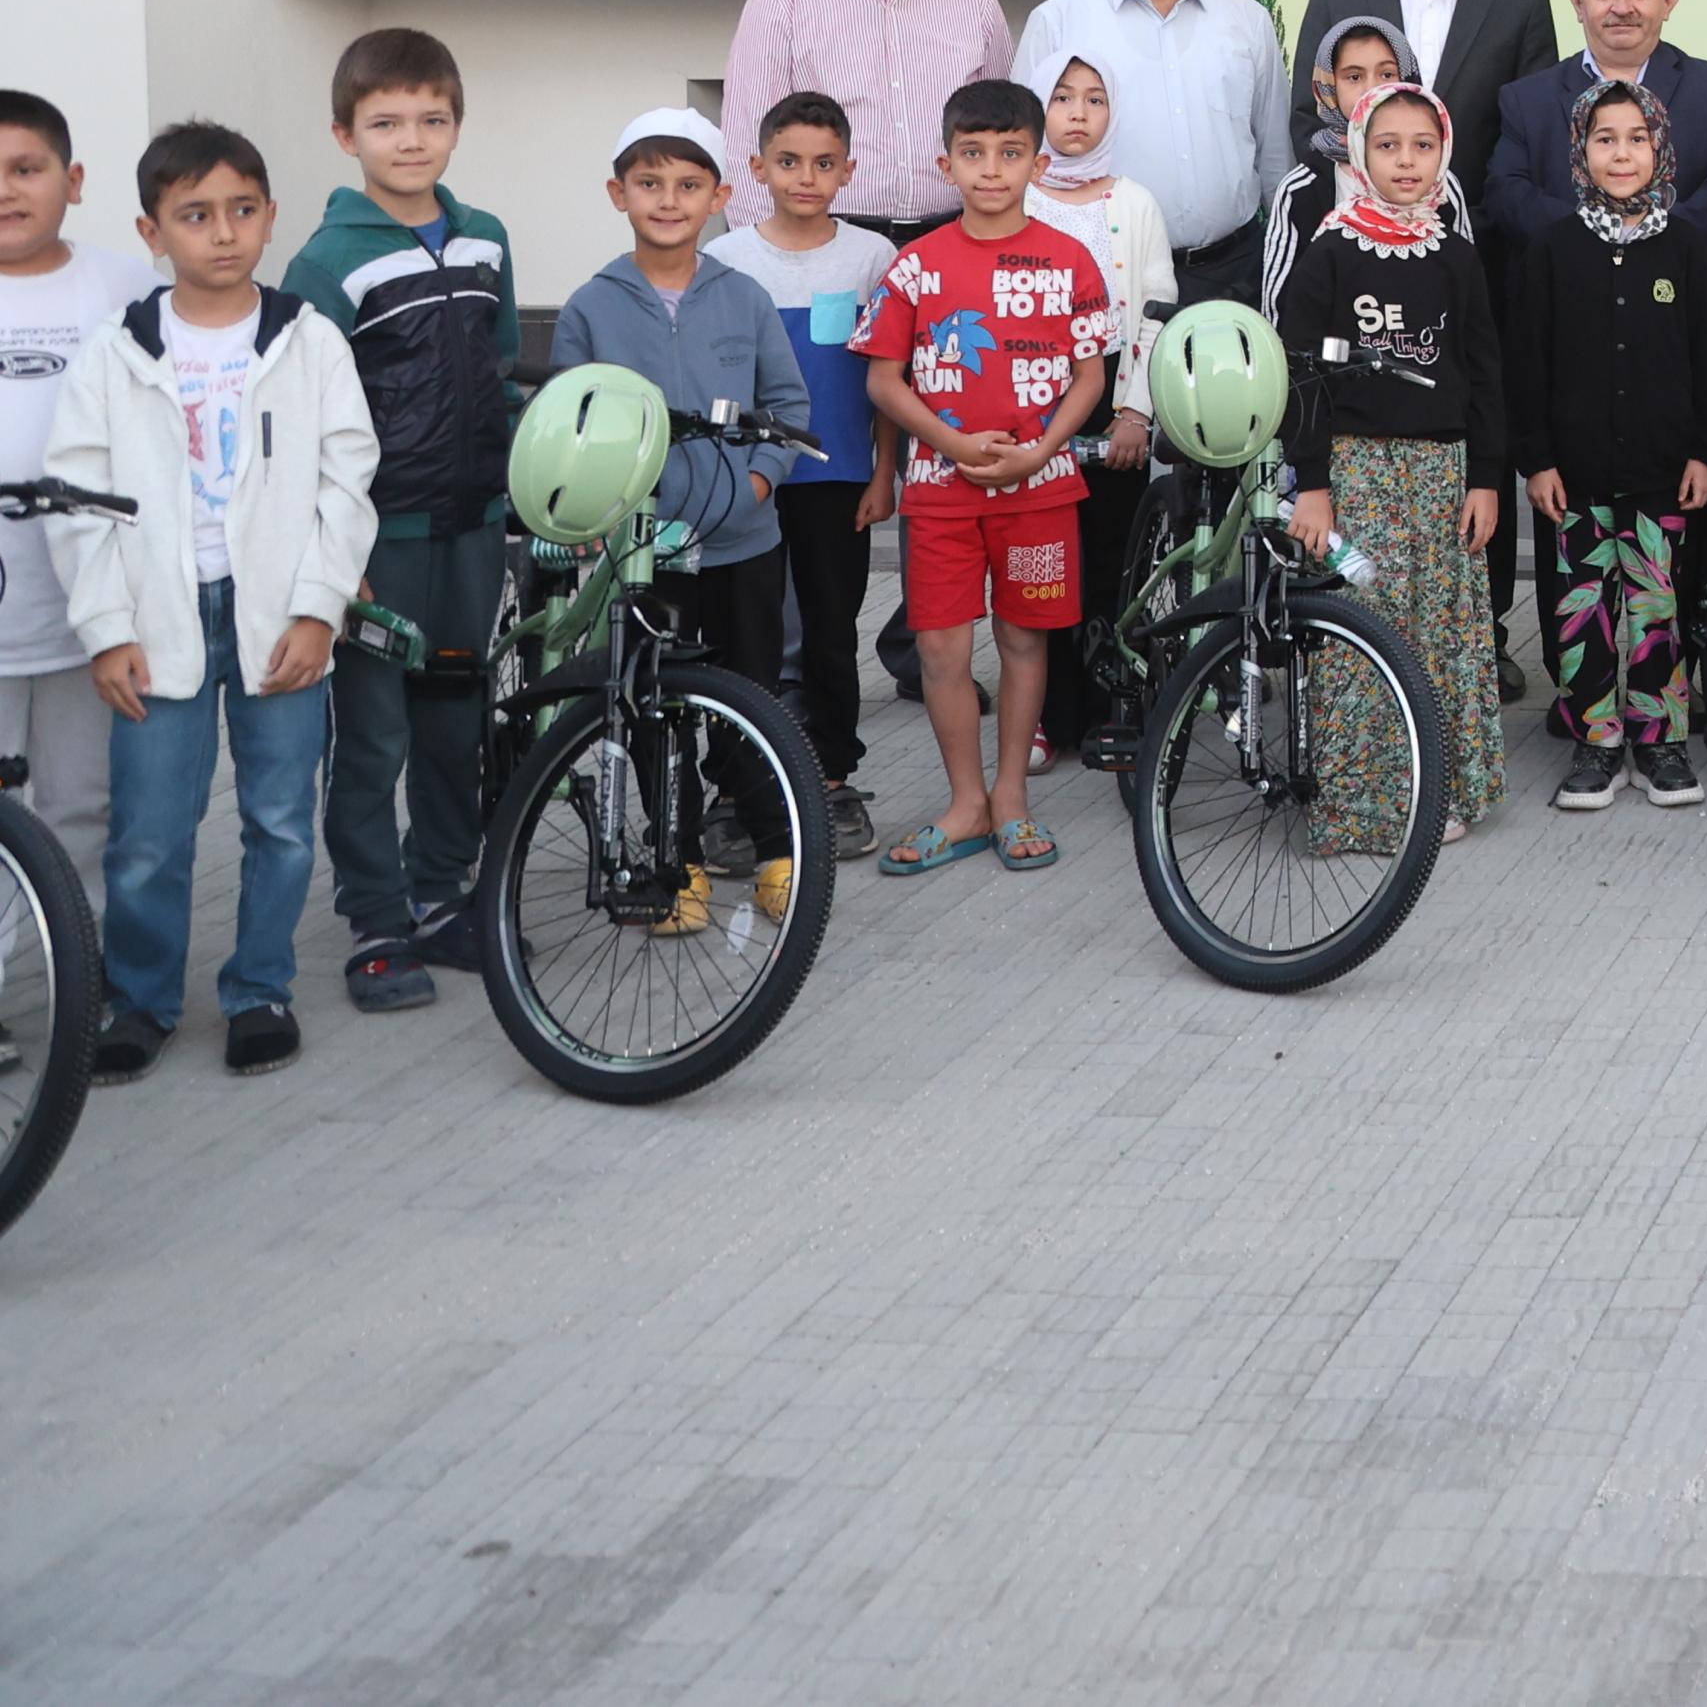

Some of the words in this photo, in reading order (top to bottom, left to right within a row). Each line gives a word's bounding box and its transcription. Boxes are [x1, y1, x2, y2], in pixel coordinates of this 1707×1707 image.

[997, 254, 1052, 268] SONIC
[992, 268, 1073, 293] BORN
[993, 292, 1035, 318] TO
[1042, 292, 1075, 316] RU
[1353, 294, 1405, 333] SE
[1004, 340, 1058, 352] SONIC
[1011, 356, 1071, 383] BOR
[1014, 382, 1054, 407] TO
[1008, 541, 1064, 558] SONIC
[1008, 555, 1064, 571] SONIC
[1008, 567, 1064, 583] SONIC
